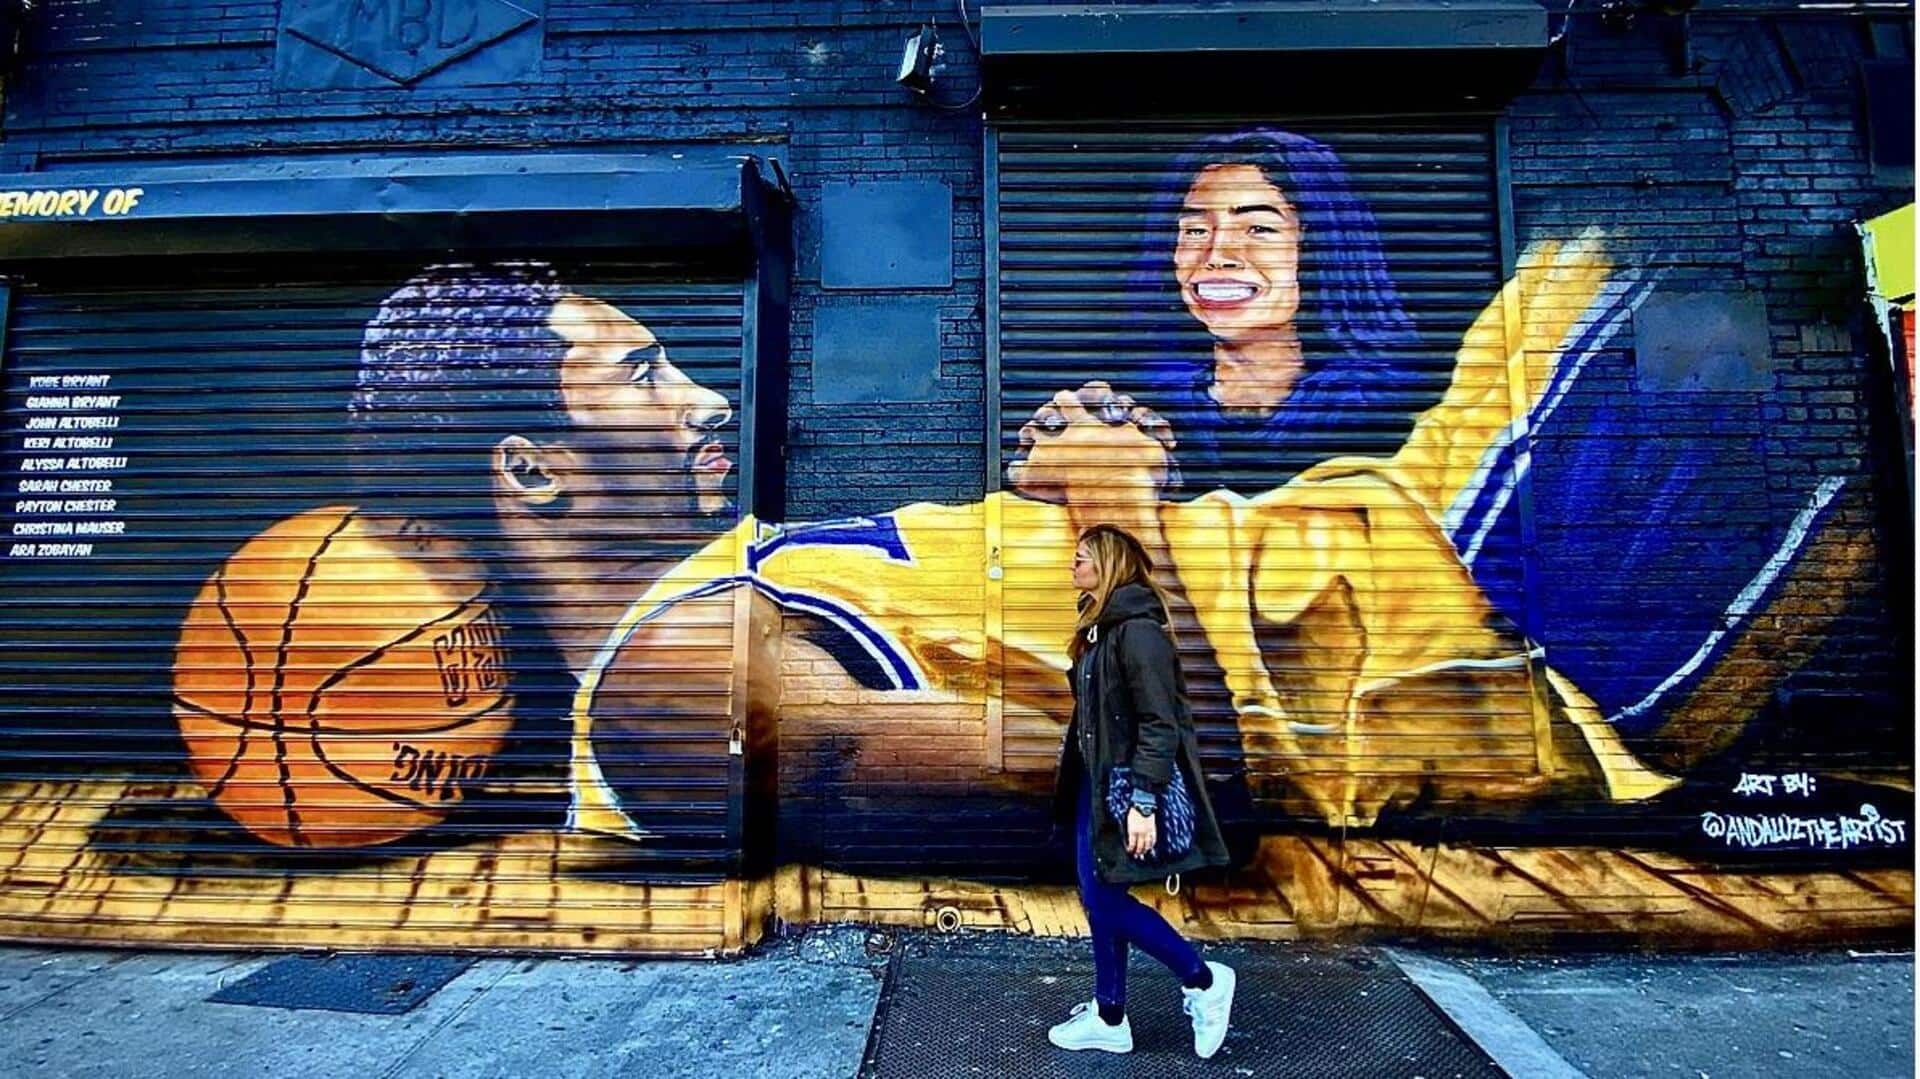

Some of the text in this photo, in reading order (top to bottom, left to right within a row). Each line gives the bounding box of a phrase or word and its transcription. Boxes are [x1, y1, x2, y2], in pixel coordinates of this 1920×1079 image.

[102, 188, 144, 215] OF
[30, 375, 110, 388] KOBE BRYANT
[26, 396, 121, 409] GIANNA BRYANT
[25, 417, 119, 429] JOHN ALTOBELLI
[24, 437, 113, 449] KERI ALTOBELLI
[21, 457, 128, 471] ALYSSA ALTOBELLI
[18, 480, 112, 492] SARAH CHESTER
[15, 499, 117, 513] PAYTON CHESTER
[12, 522, 125, 535] CHRISTINA MAUSER
[9, 544, 93, 557] ARA ZOBAYAN
[1732, 772, 1816, 797] ART BY:
